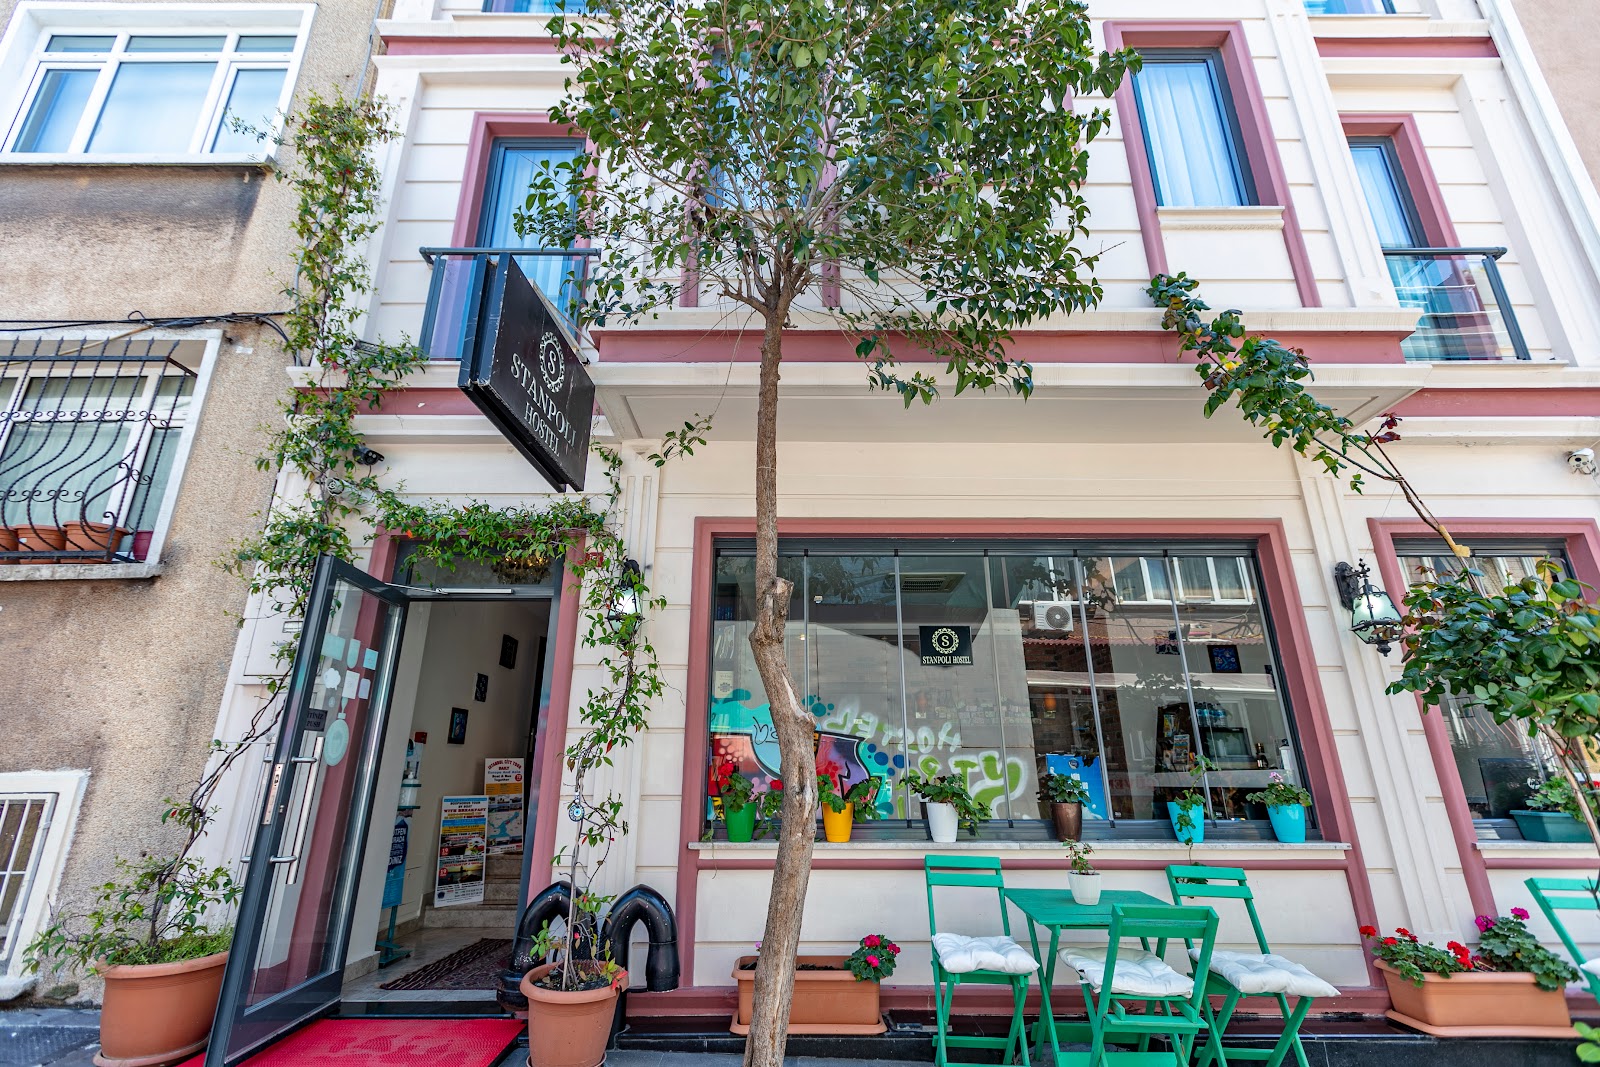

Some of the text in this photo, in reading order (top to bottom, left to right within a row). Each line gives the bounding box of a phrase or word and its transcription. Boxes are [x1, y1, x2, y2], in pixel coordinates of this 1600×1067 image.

[547, 350, 556, 374] S
[510, 352, 576, 448] STANPOLI
[523, 402, 560, 457] HOSTEL
[941, 635, 950, 647] S
[922, 655, 971, 664] STANPOLI HOSTEL
